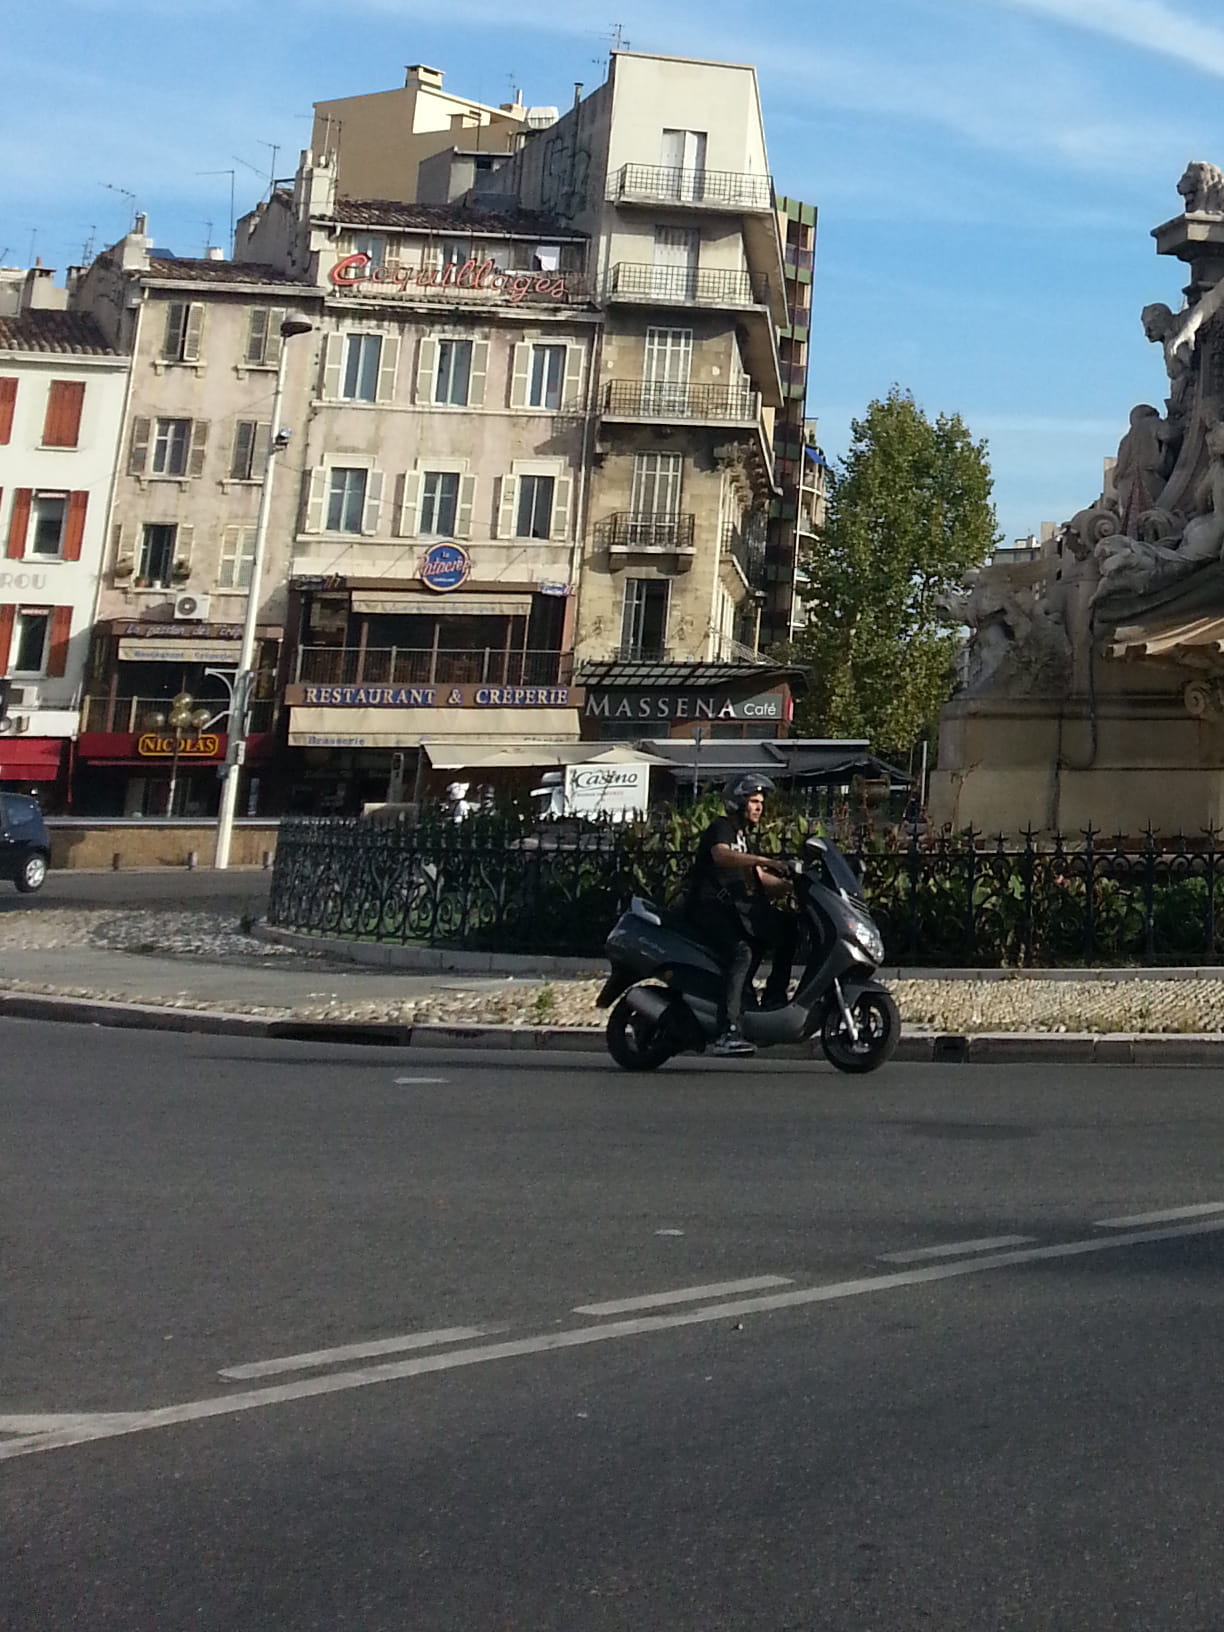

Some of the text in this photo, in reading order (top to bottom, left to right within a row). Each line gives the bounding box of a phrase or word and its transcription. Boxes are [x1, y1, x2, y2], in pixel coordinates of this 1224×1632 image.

[330, 253, 568, 301] Coquillages
[305, 685, 568, 705] RESTAURANT & CRÊPERIE
[585, 693, 776, 718] MASSENA Café
[143, 738, 215, 752] NICOLAS
[575, 770, 638, 788] Casino
